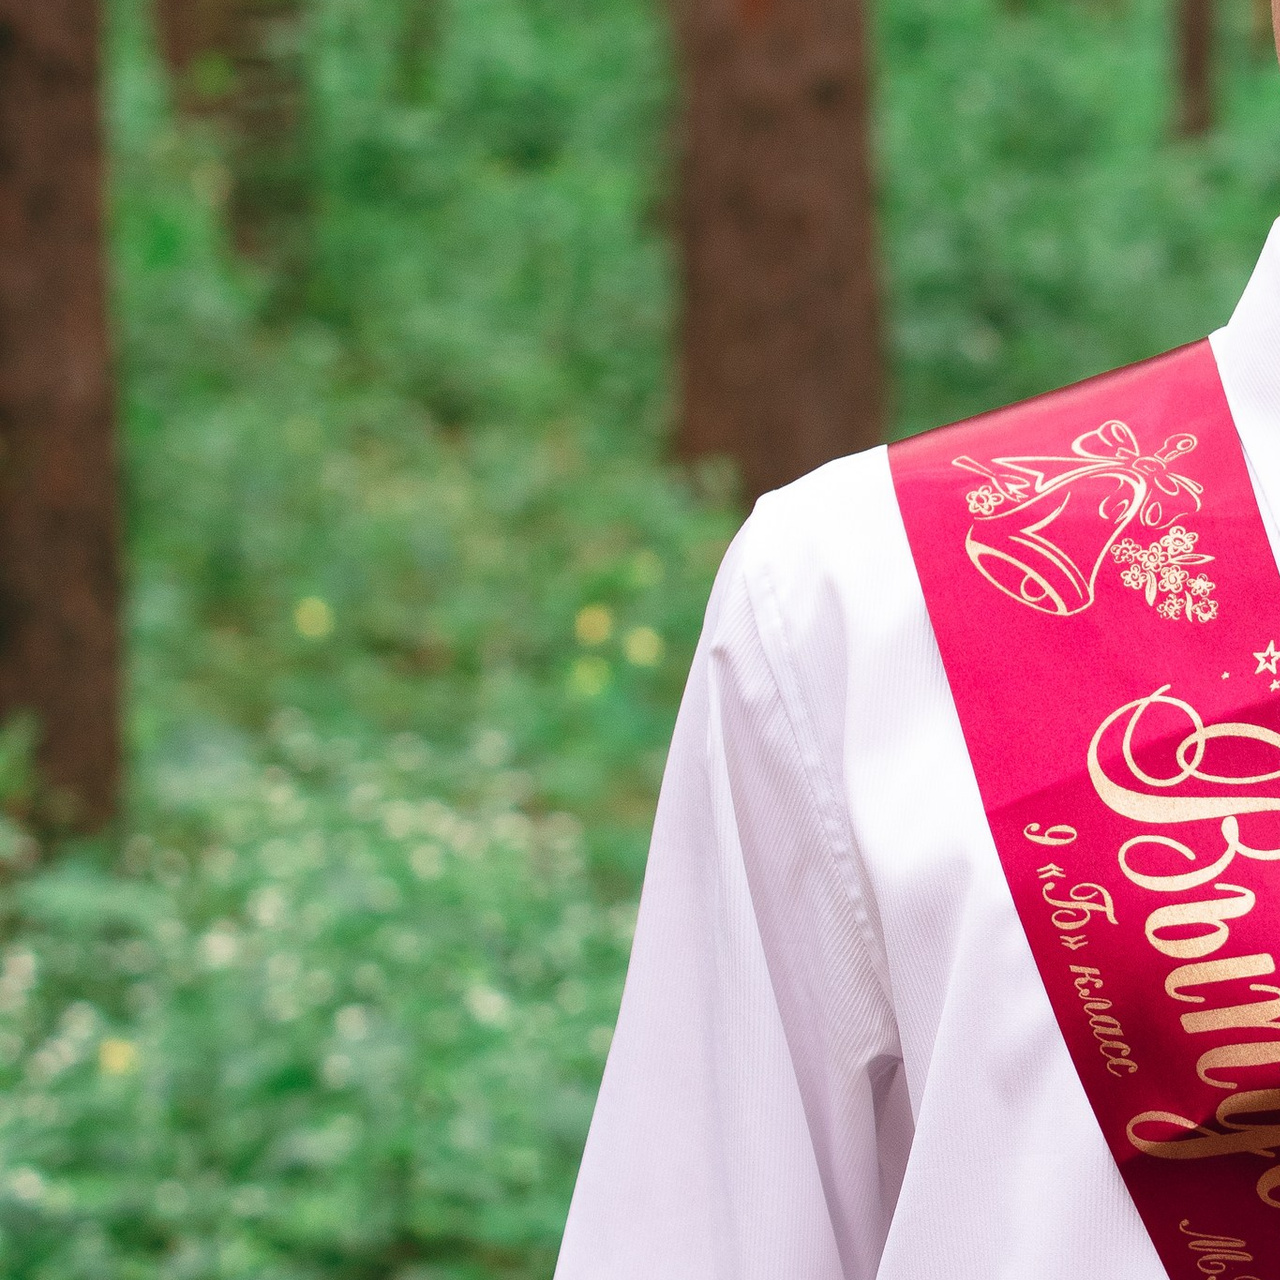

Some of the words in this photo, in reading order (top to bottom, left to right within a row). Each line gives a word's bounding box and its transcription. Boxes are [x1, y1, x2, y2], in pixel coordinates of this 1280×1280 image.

[1024, 822, 1077, 846] 9
[1038, 861, 1119, 951] «Б»
[1070, 963, 1142, 1079] класс
